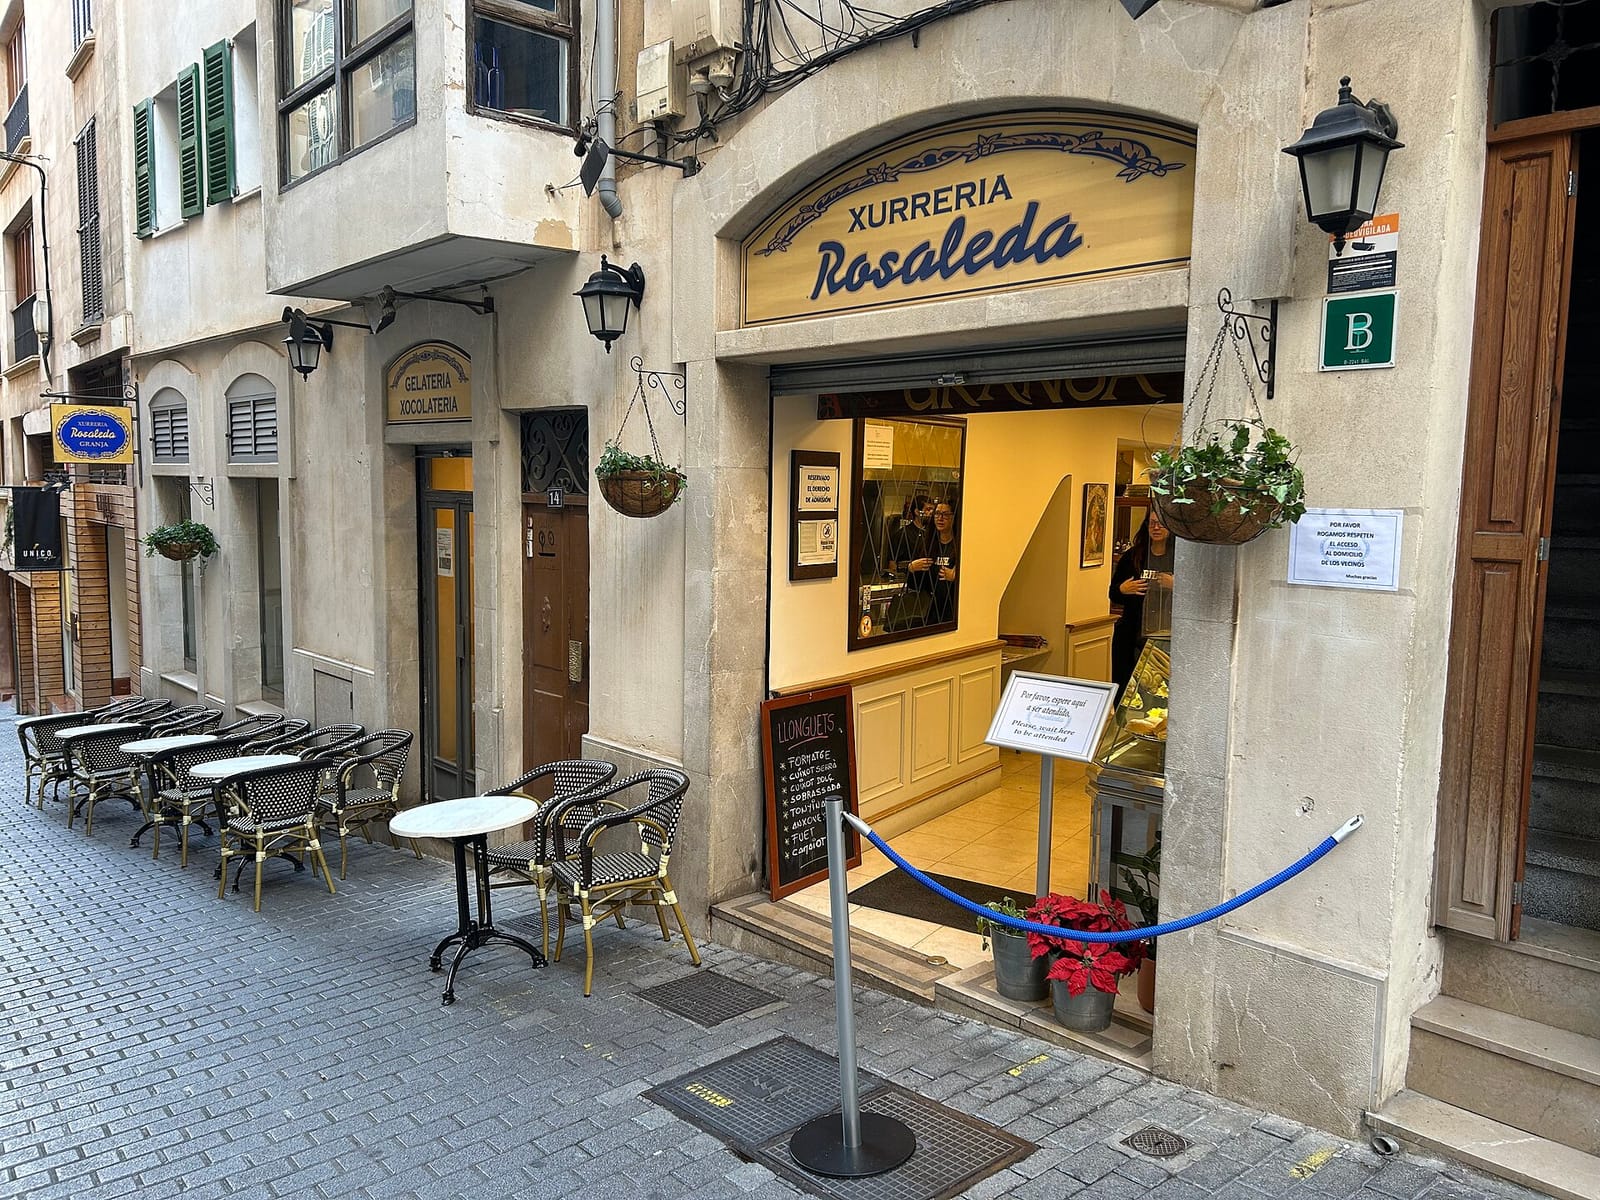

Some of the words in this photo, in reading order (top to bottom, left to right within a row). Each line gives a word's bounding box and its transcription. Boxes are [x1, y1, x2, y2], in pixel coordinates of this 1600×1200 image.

[848, 174, 1013, 234] XURRERIA
[810, 200, 1084, 300] Rosaleda
[1344, 312, 1373, 350] B
[405, 372, 451, 391] GELATERIA
[400, 396, 458, 415] XOCOLATERIA
[70, 427, 116, 439] Rosaleda
[549, 491, 560, 505] 14
[1021, 690, 1033, 699] Por
[1031, 692, 1051, 703] favor,
[1051, 696, 1071, 706] espere
[1031, 705, 1042, 713] ser
[778, 712, 835, 744] LLONGUETS
[1014, 728, 1022, 736] to
[1023, 729, 1033, 737] be
[1033, 732, 1068, 743] attended
[1039, 724, 1058, 734] wait
[1058, 727, 1076, 736] here
[788, 750, 831, 769] FORMATGE
[790, 782, 841, 804] SOBRASSADA
[791, 826, 815, 845] FUET
